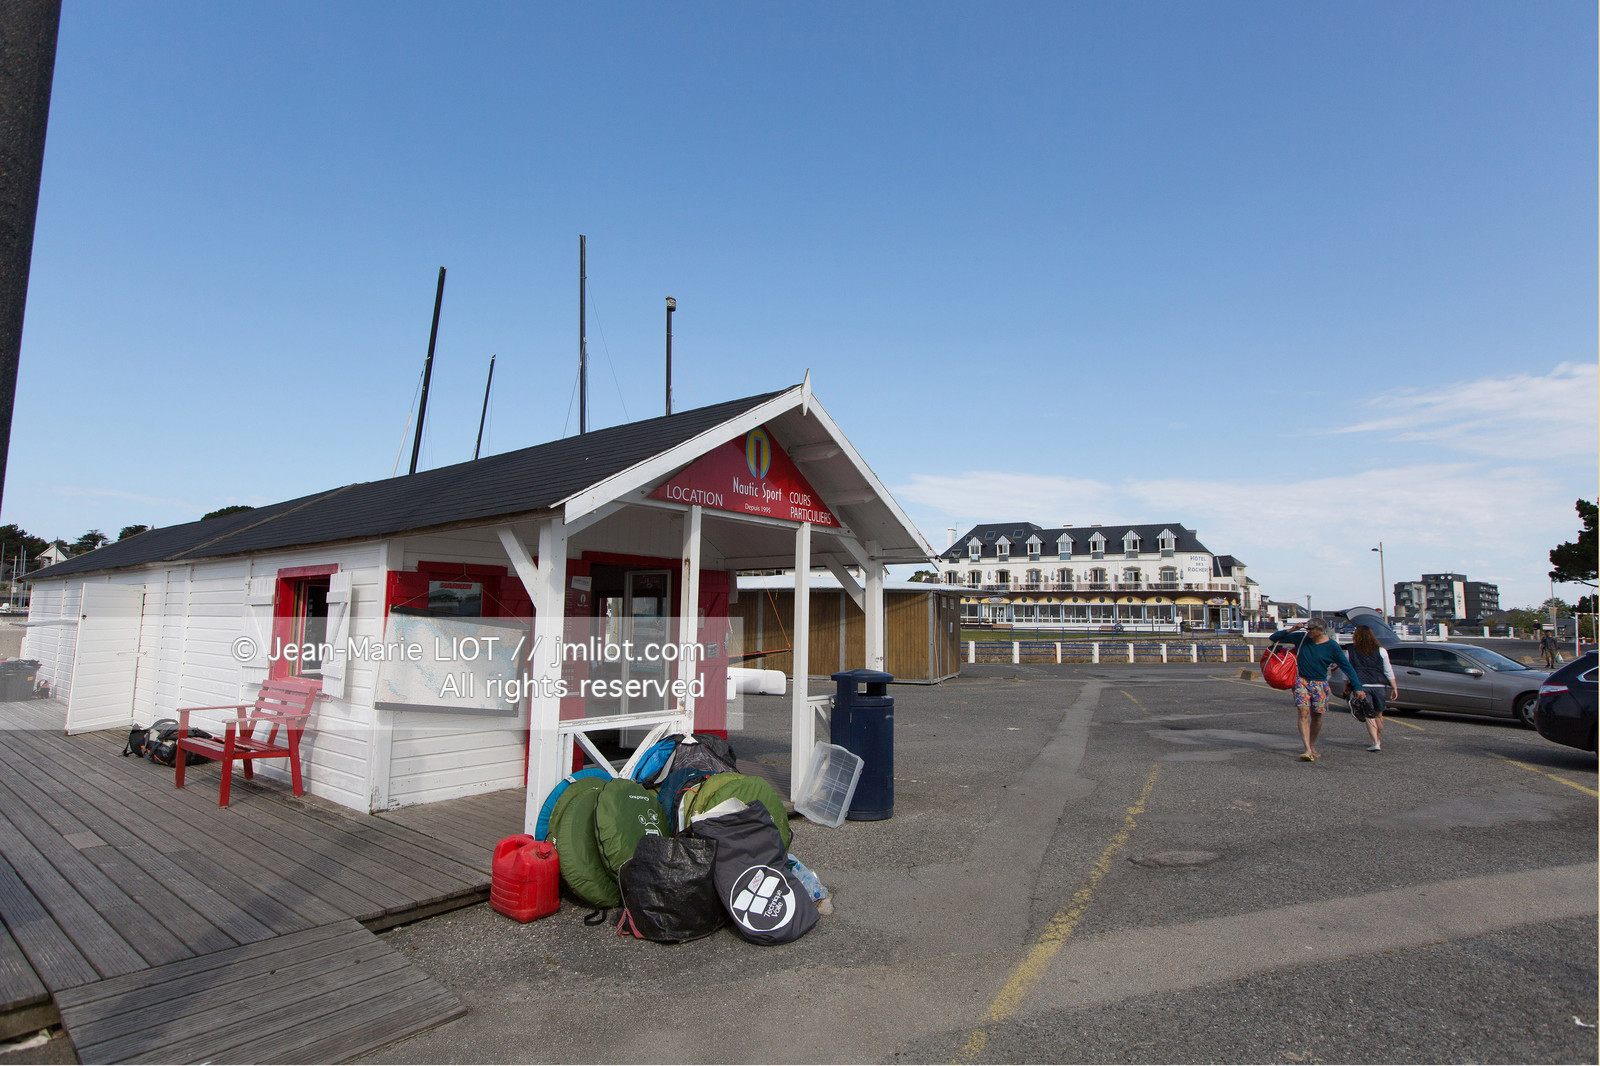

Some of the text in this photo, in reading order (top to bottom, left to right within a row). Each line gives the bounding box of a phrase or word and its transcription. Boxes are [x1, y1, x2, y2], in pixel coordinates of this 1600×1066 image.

[666, 484, 724, 507] LOCATION
[732, 476, 782, 503] Nautic Sport
[789, 491, 811, 507] COURS
[744, 503, 760, 513] Depuis
[790, 506, 832, 525] PARTICULIERS
[763, 889, 783, 918] Technique
[771, 901, 784, 918] Voile
